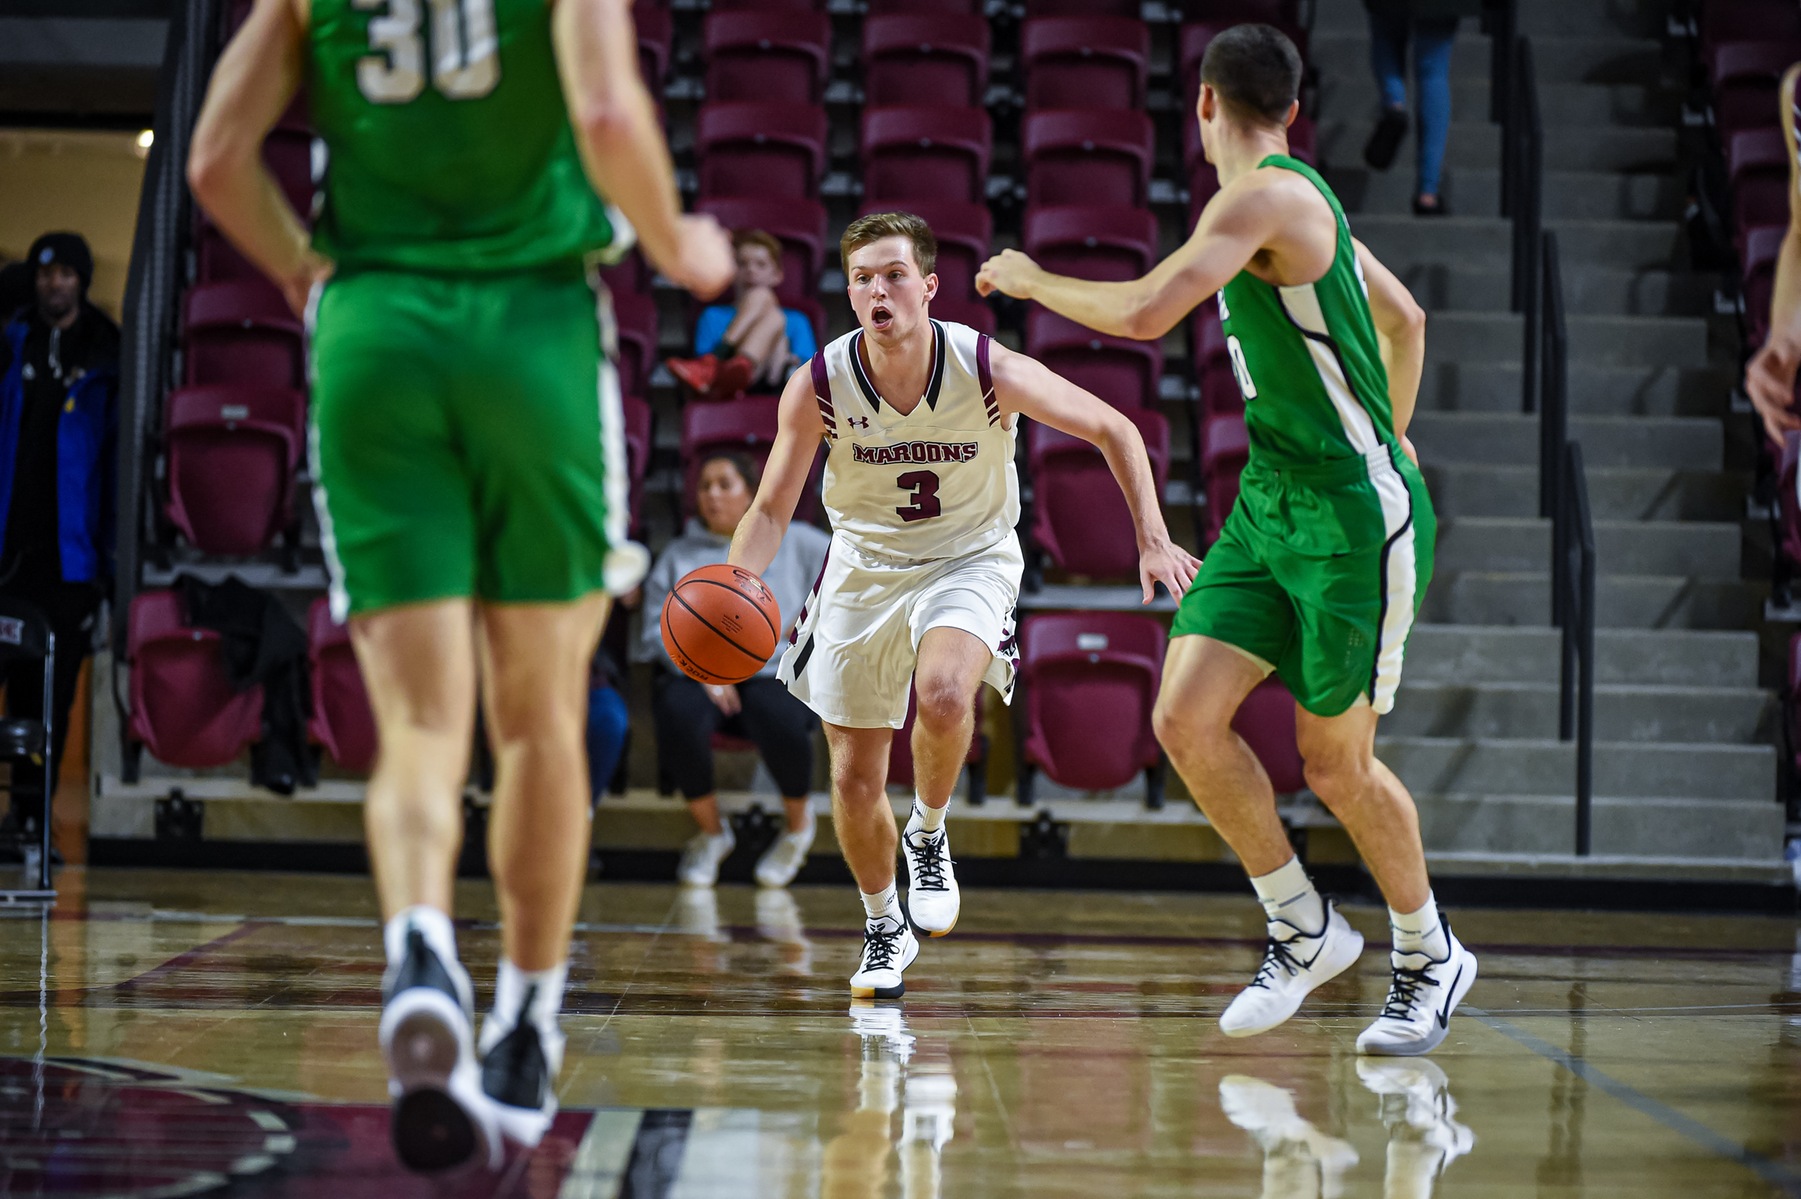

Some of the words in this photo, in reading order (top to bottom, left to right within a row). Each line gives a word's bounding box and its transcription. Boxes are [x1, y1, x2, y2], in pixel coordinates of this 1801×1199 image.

[352, 0, 500, 103] 30
[853, 441, 979, 464] MAROONS
[896, 470, 941, 522] 3
